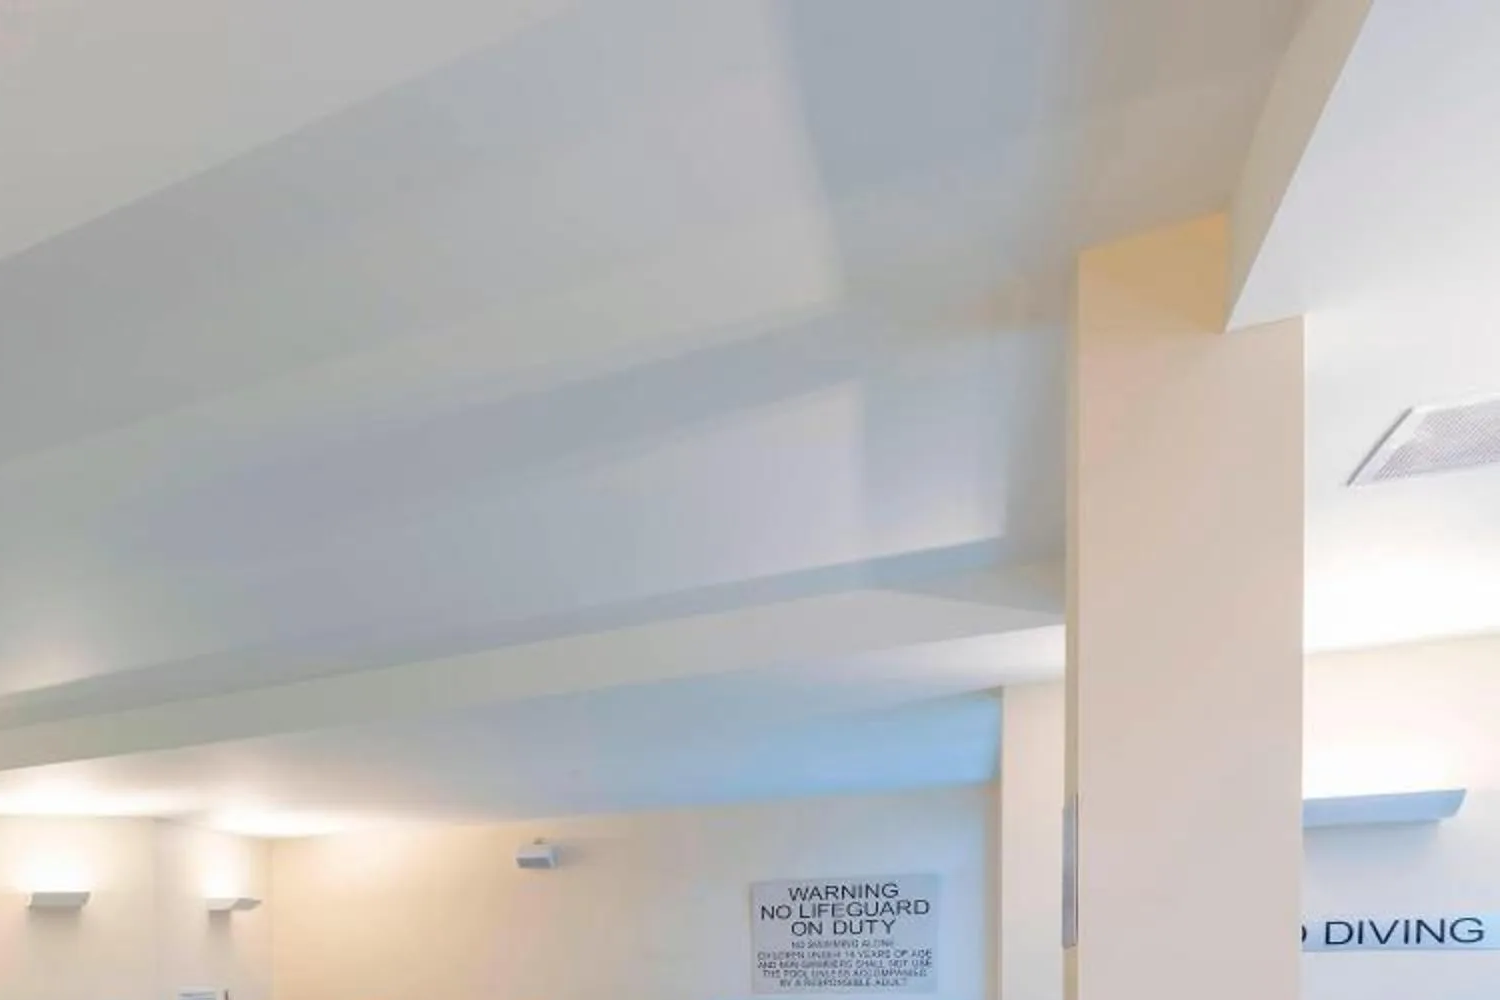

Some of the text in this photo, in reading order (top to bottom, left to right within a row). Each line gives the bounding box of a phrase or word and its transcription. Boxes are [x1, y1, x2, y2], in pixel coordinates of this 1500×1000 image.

[789, 883, 899, 901] WARNING
[761, 900, 931, 920] NO LIFEGUARD
[791, 919, 896, 936] ON DUTY
[1325, 917, 1485, 945] DIVING
